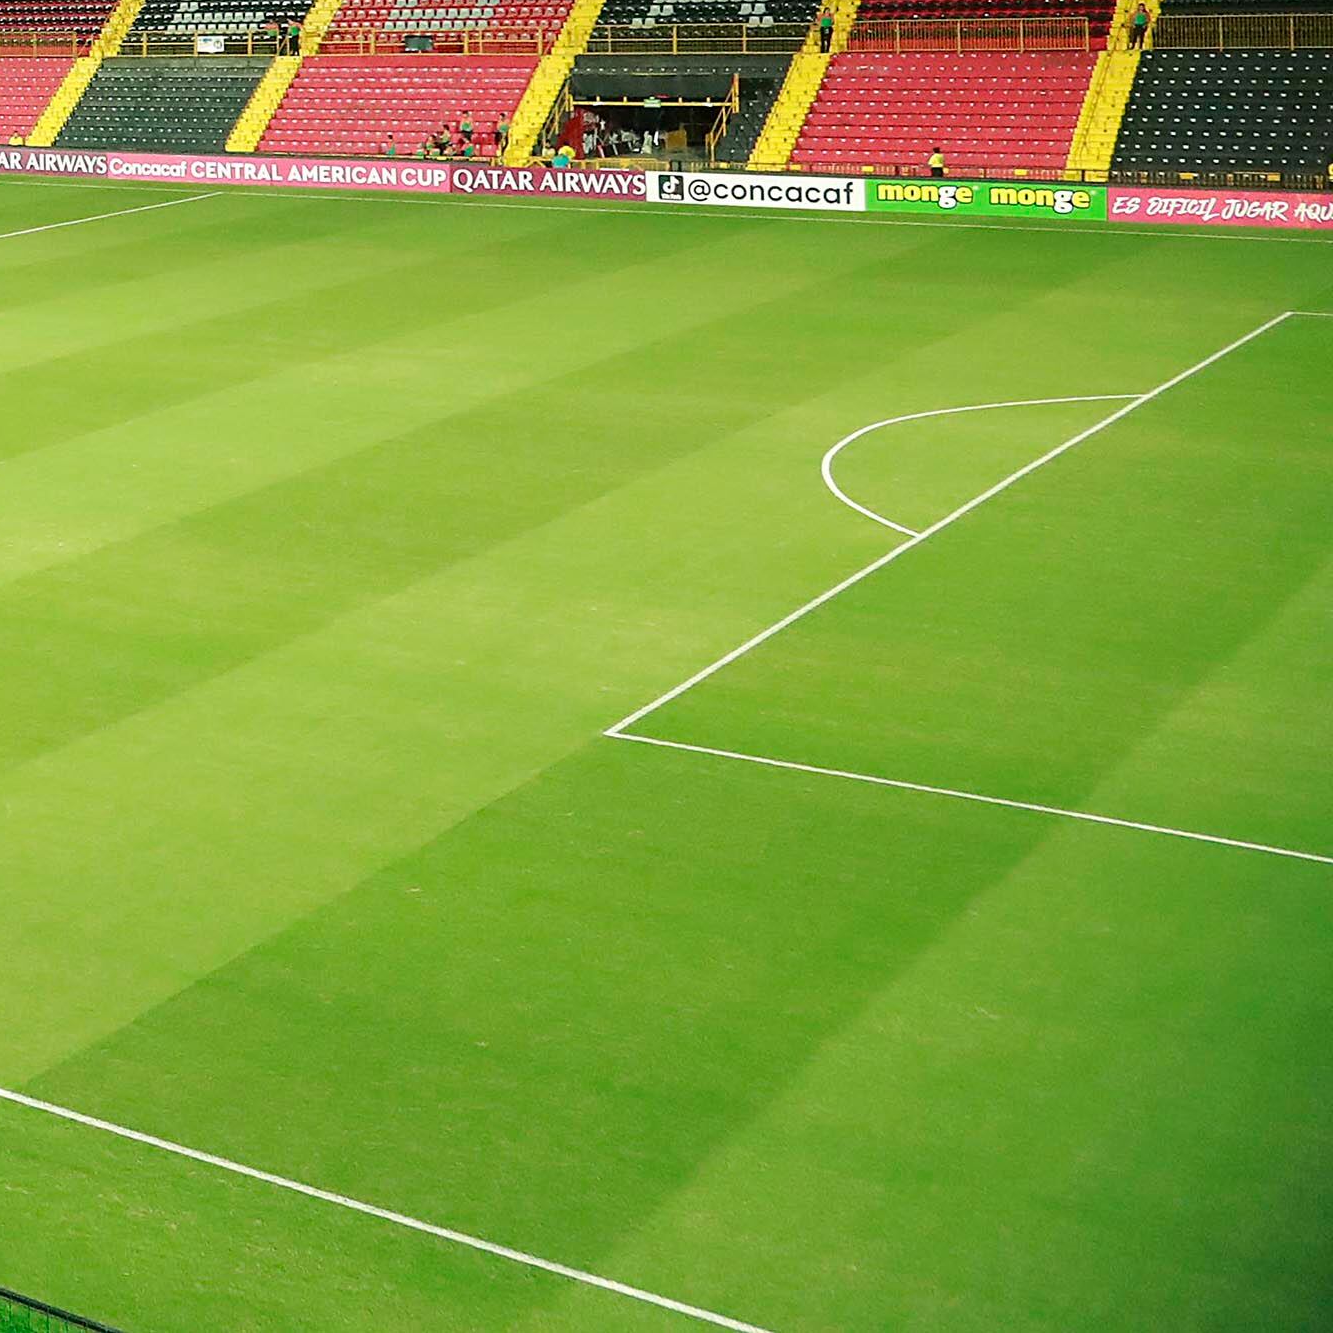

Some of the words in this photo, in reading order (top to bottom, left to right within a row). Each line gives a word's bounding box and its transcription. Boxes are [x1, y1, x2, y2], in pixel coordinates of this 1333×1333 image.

[25, 153, 108, 175] AIRWAYS
[108, 157, 187, 178] Concacaf
[190, 163, 283, 182] CENTRAL
[287, 164, 397, 187] AMERICAN
[400, 168, 447, 187] CUP
[452, 168, 534, 195] QATAR
[539, 170, 646, 197] AIRWAYS
[688, 178, 854, 206] @concacaf
[876, 183, 973, 210] monge
[989, 187, 1091, 214] monge
[1112, 196, 1141, 215] ES
[1221, 199, 1290, 222] JUGAR
